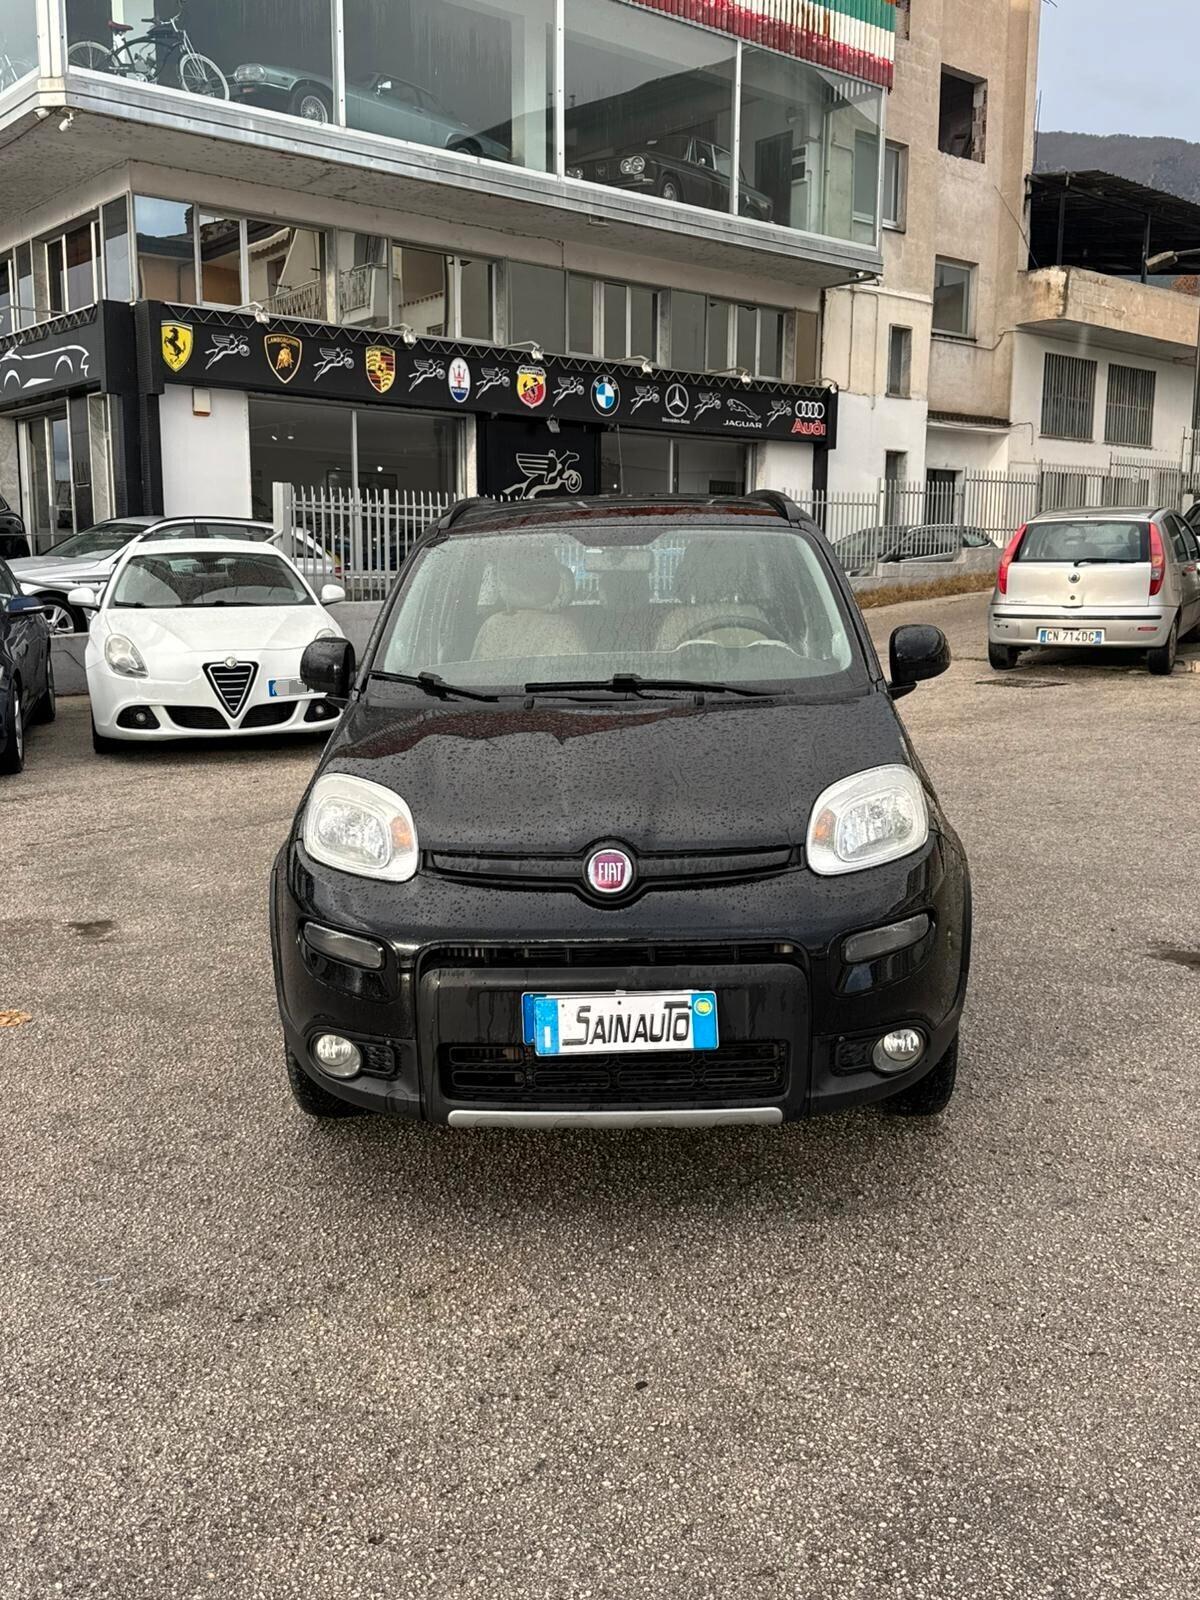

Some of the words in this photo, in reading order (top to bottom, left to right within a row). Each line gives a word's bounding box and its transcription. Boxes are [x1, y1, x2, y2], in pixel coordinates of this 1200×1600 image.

[722, 419, 763, 429] JAGUAR
[791, 418, 826, 436] Audi
[1046, 631, 1060, 641] CN
[598, 862, 623, 882] FIAT
[561, 1000, 690, 1046] SAINAUTO
